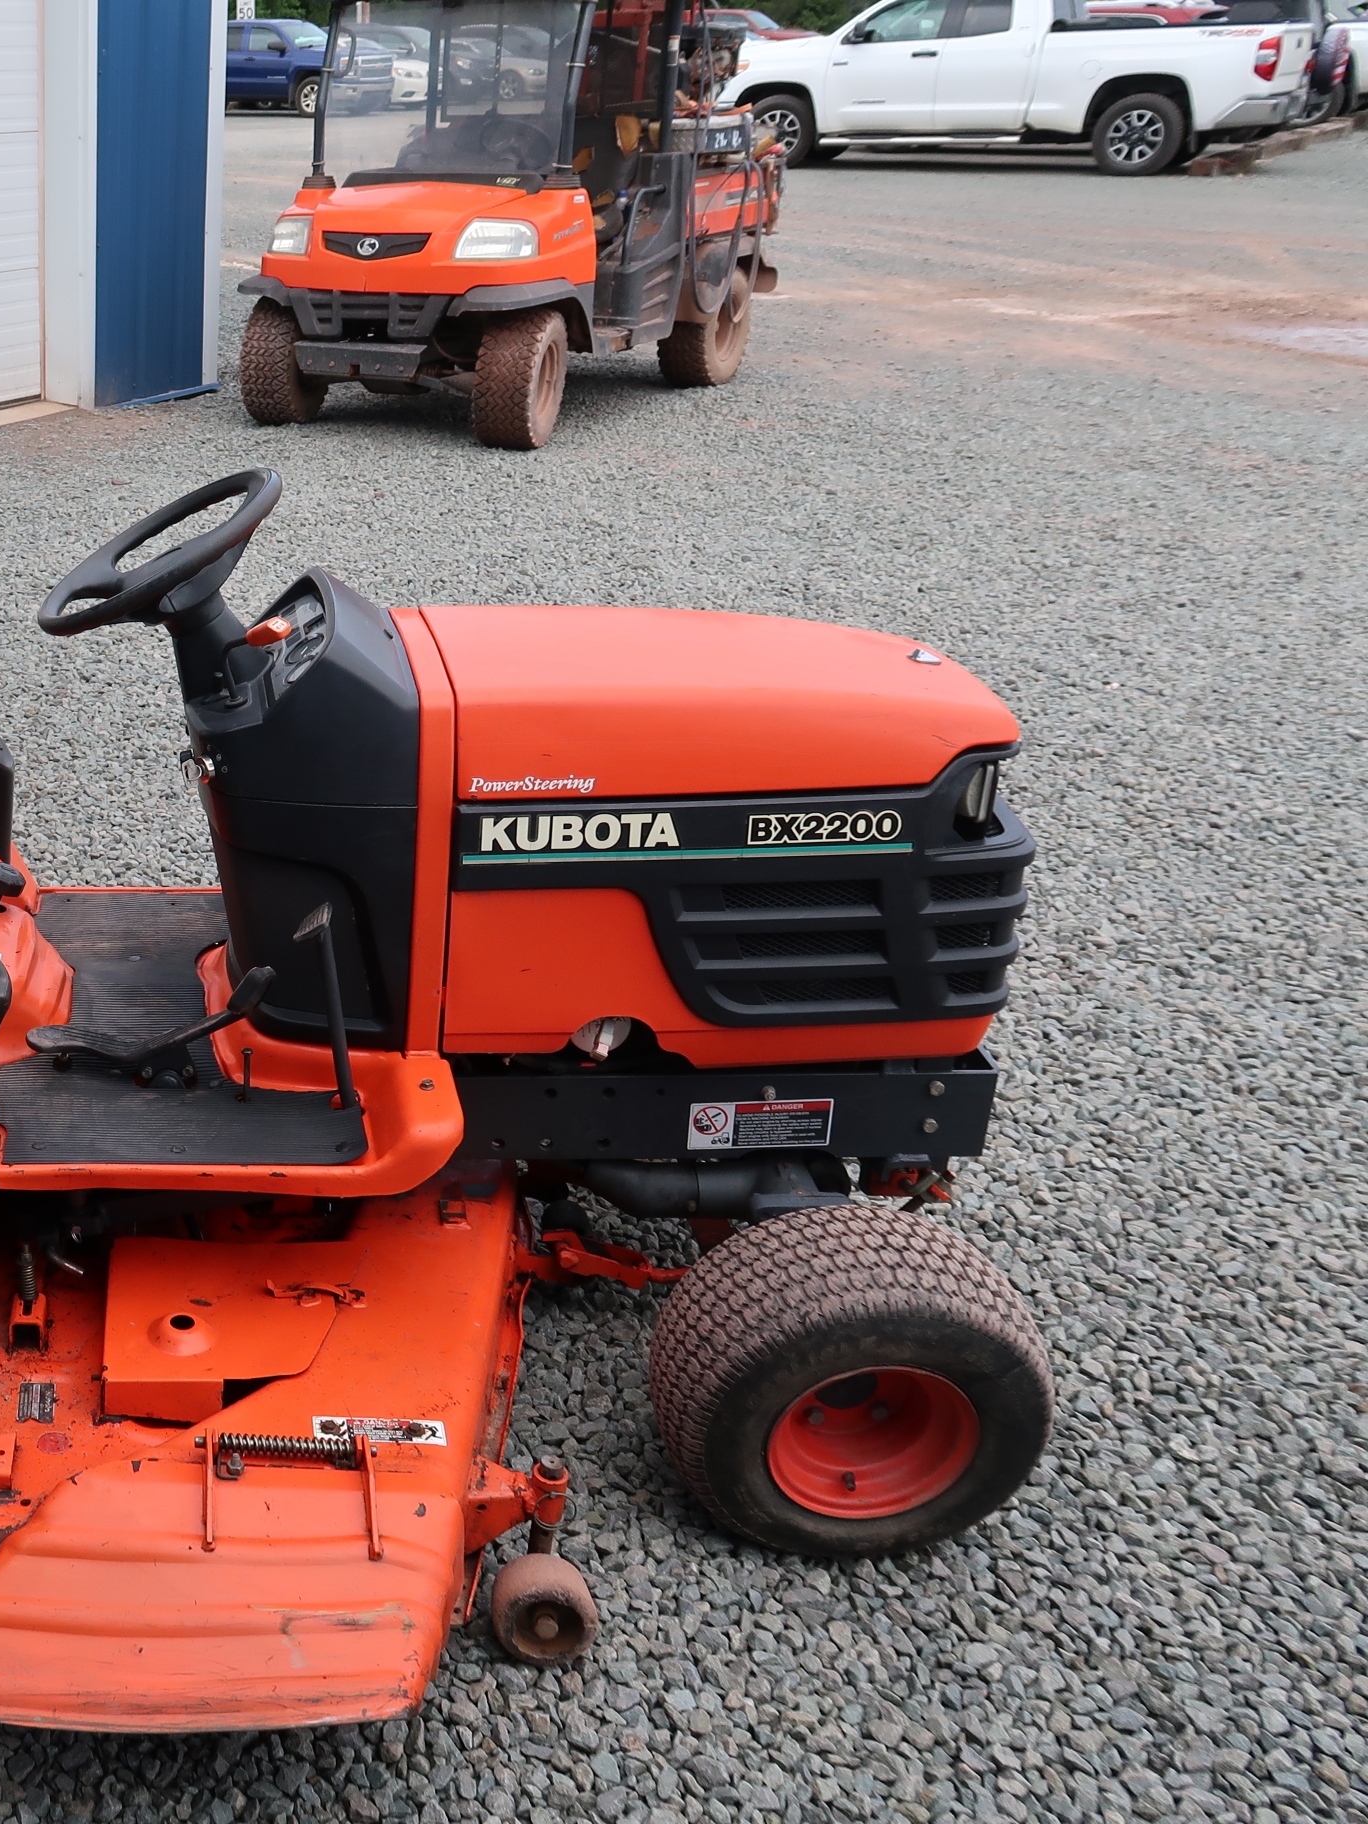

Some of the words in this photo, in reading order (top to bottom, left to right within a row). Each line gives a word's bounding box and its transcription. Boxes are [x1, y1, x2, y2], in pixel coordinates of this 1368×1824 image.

[239, 8, 253, 19] 50
[468, 774, 596, 794] PowerSteering
[479, 811, 680, 853] KUBOTA
[747, 809, 903, 846] BX2200
